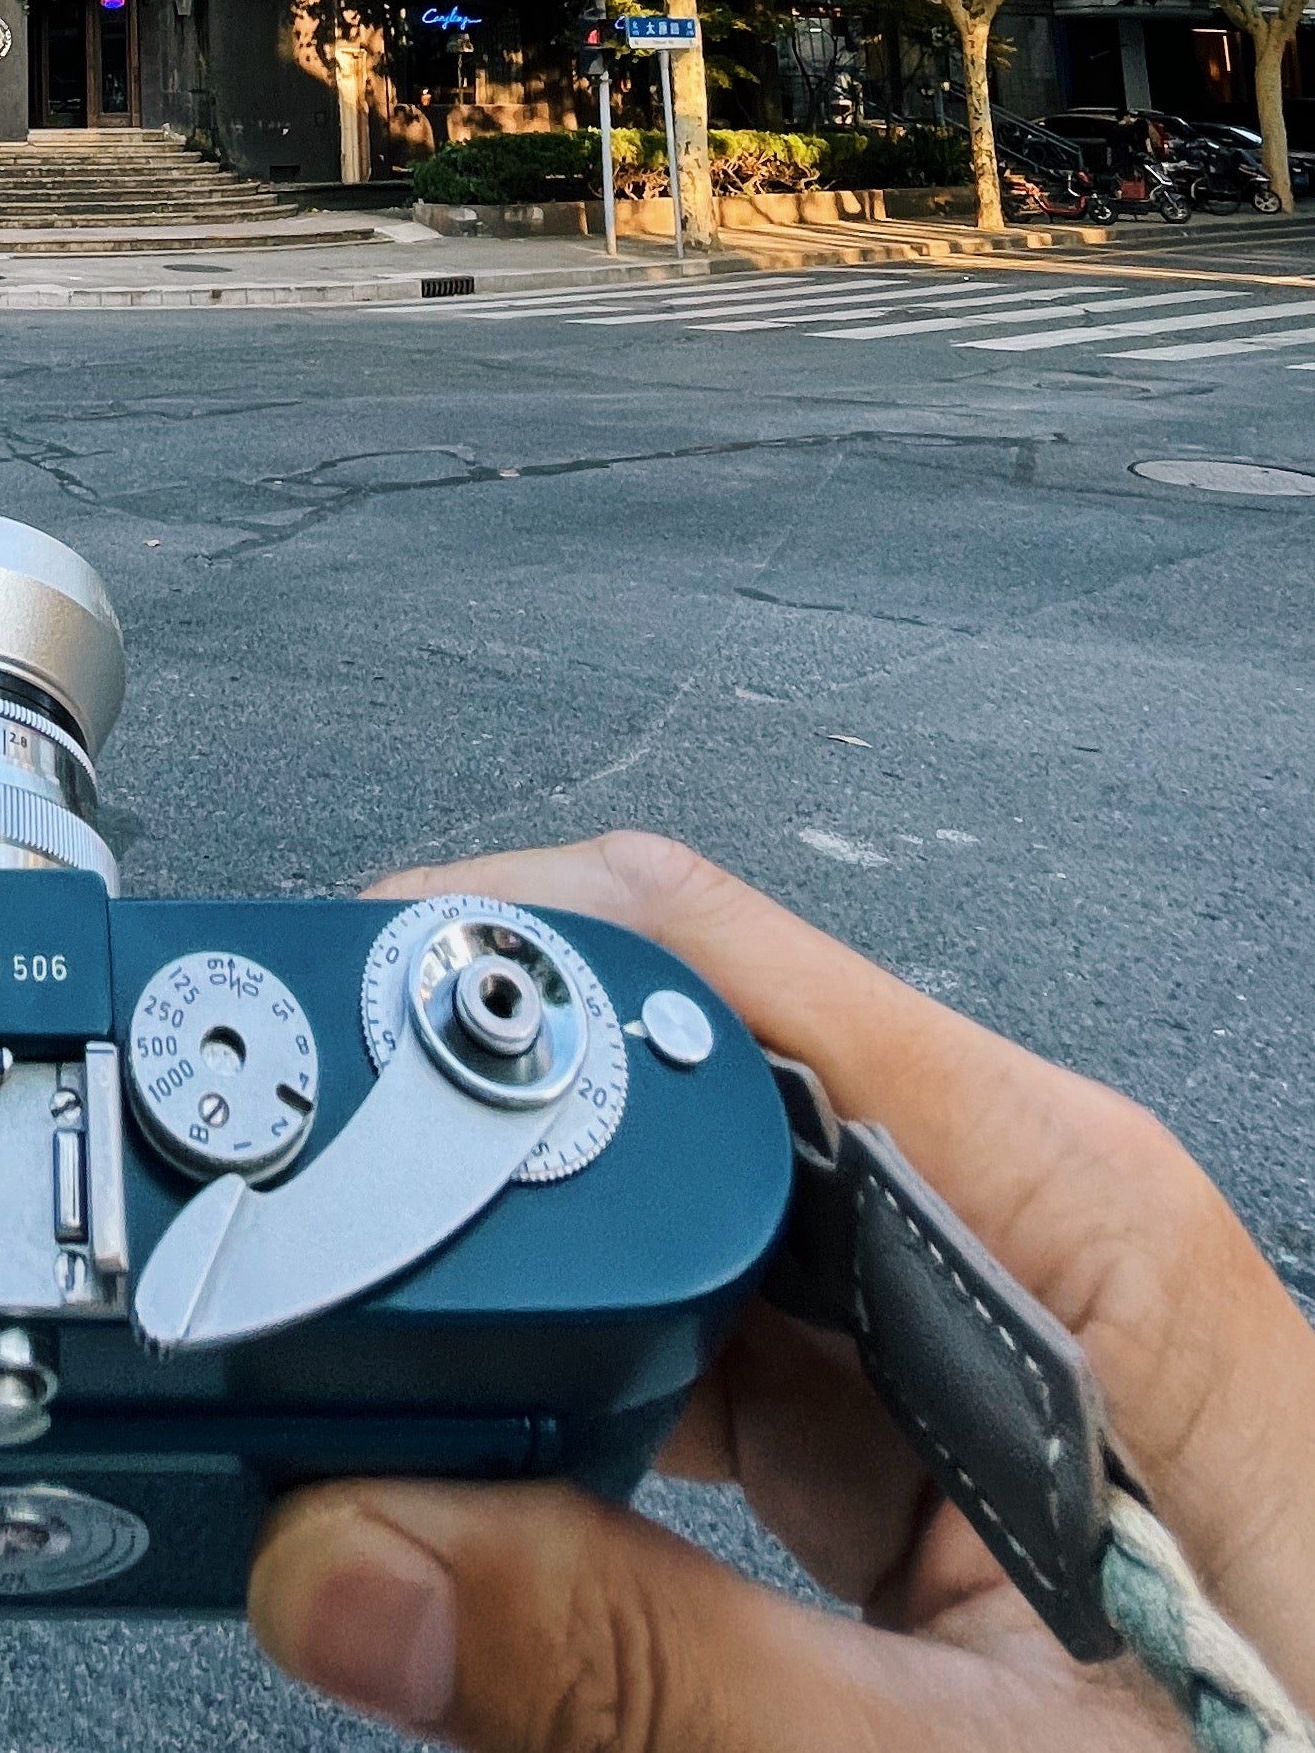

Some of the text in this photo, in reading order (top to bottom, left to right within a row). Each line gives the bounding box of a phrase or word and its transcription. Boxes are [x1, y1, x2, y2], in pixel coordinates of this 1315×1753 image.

[9, 732, 28, 748] 2.8
[169, 966, 200, 1005] 125
[207, 958, 227, 985] 60
[242, 968, 264, 997] 30
[144, 996, 184, 1028] 250
[272, 998, 295, 1022] 15
[137, 1035, 178, 1058] 500
[147, 1059, 194, 1103] 1000
[578, 1077, 607, 1109] 20
[189, 1124, 209, 1145] B
